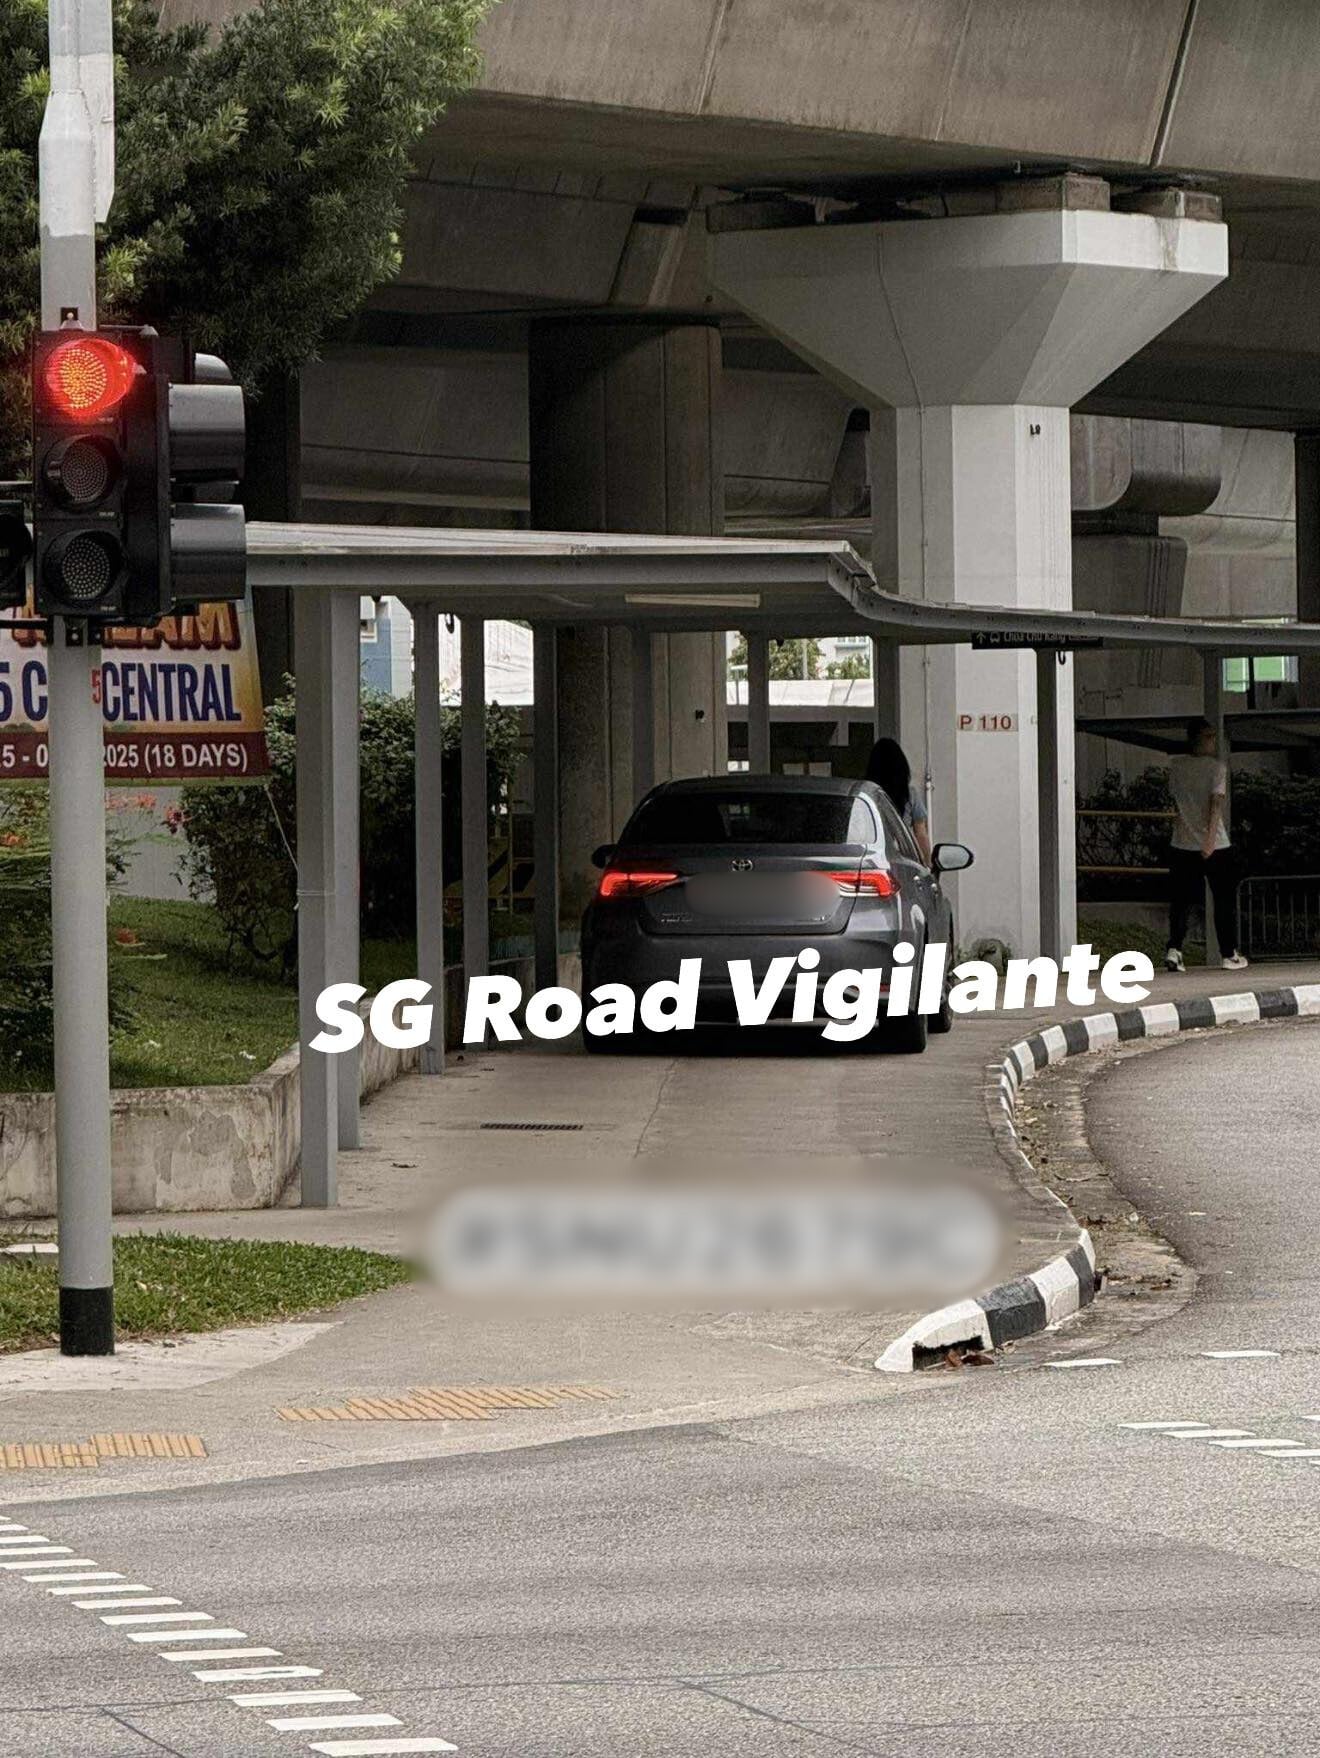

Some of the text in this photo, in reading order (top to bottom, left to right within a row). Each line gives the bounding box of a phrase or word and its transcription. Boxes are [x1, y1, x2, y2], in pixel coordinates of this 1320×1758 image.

[102, 661, 242, 721] CENTRAL
[960, 714, 1012, 730] P 110
[144, 743, 176, 773] (18
[181, 743, 248, 773] DAYS)
